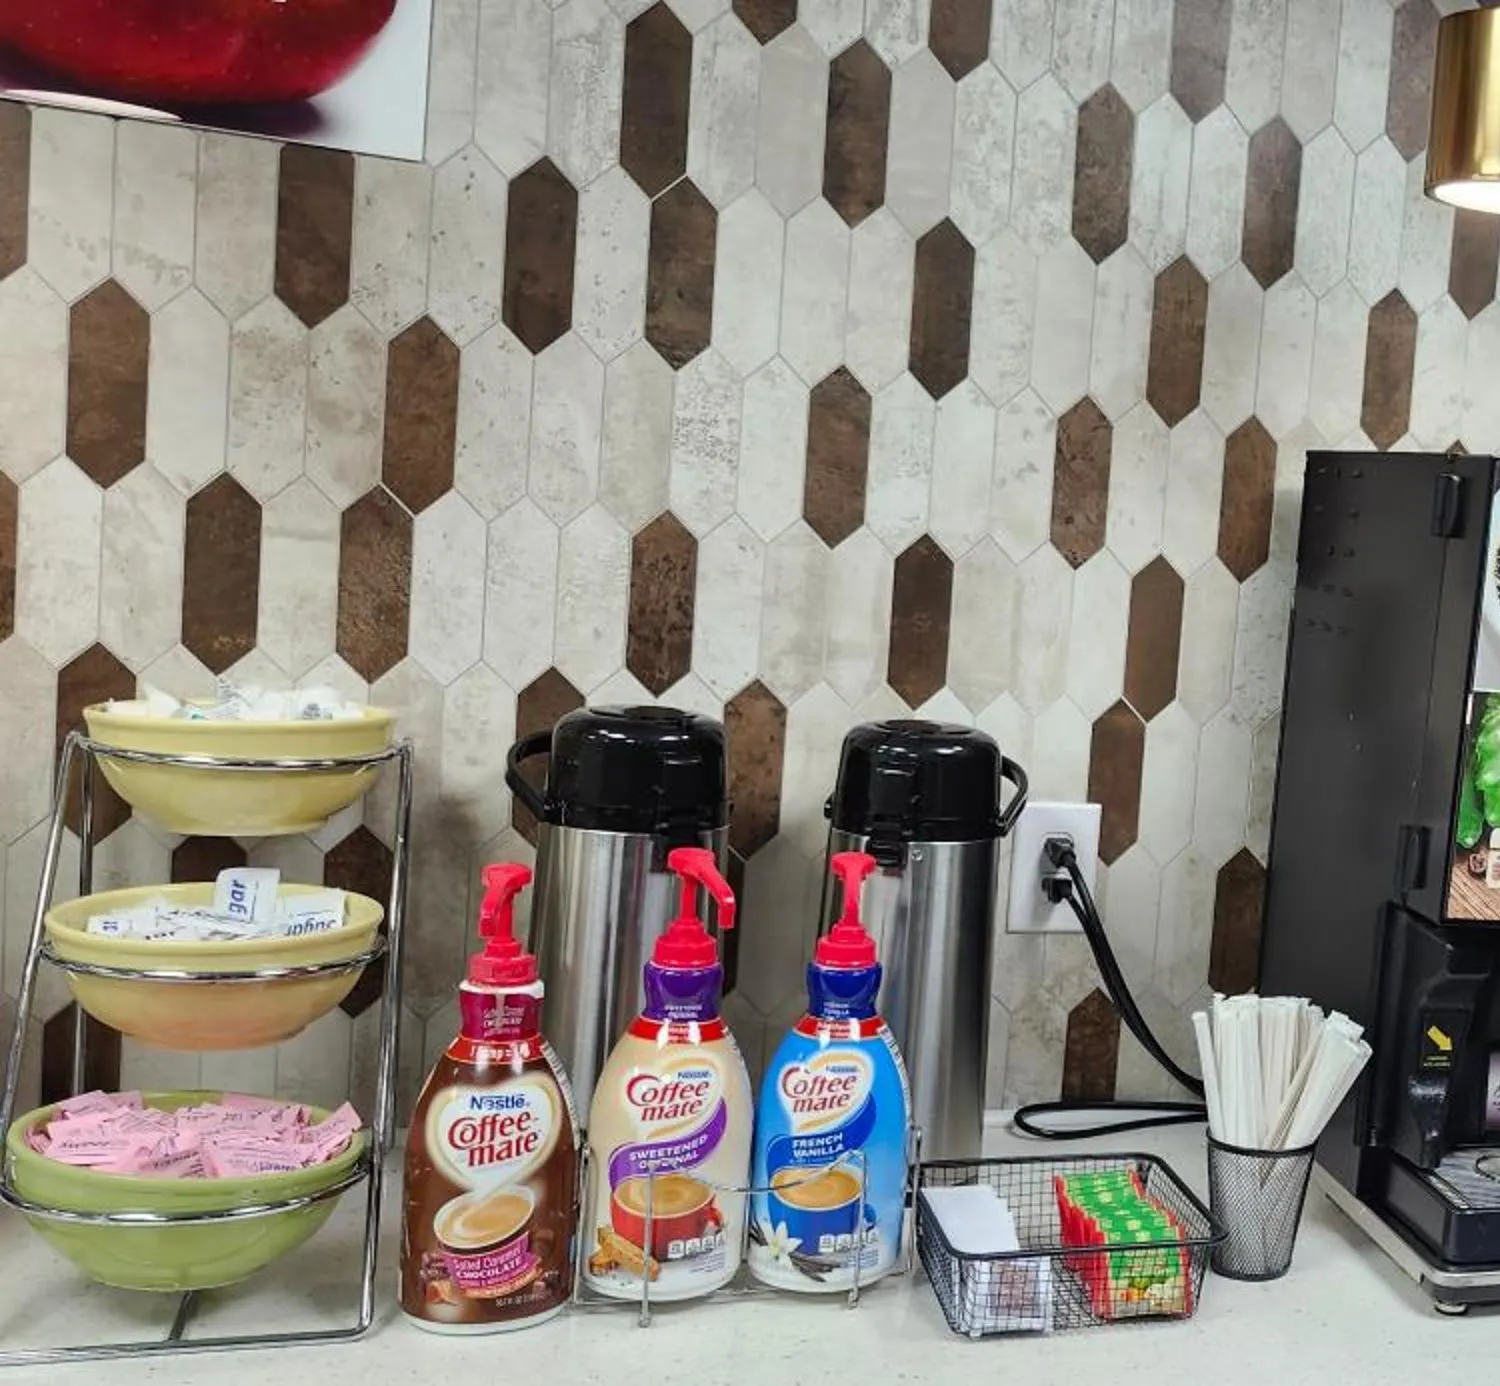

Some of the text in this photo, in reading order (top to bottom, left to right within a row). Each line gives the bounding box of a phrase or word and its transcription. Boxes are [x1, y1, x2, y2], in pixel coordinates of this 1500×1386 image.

[626, 1074, 710, 1107] Coffee
[781, 1067, 857, 1099] Coffee
[641, 1099, 703, 1121] mate
[793, 1093, 850, 1113] mate
[468, 1131, 539, 1167] mate
[629, 1134, 708, 1161] SWEETENED
[792, 1132, 844, 1148] FRENCH
[793, 1143, 845, 1158] VANILLA
[455, 1257, 523, 1280] CHOCOLATE
